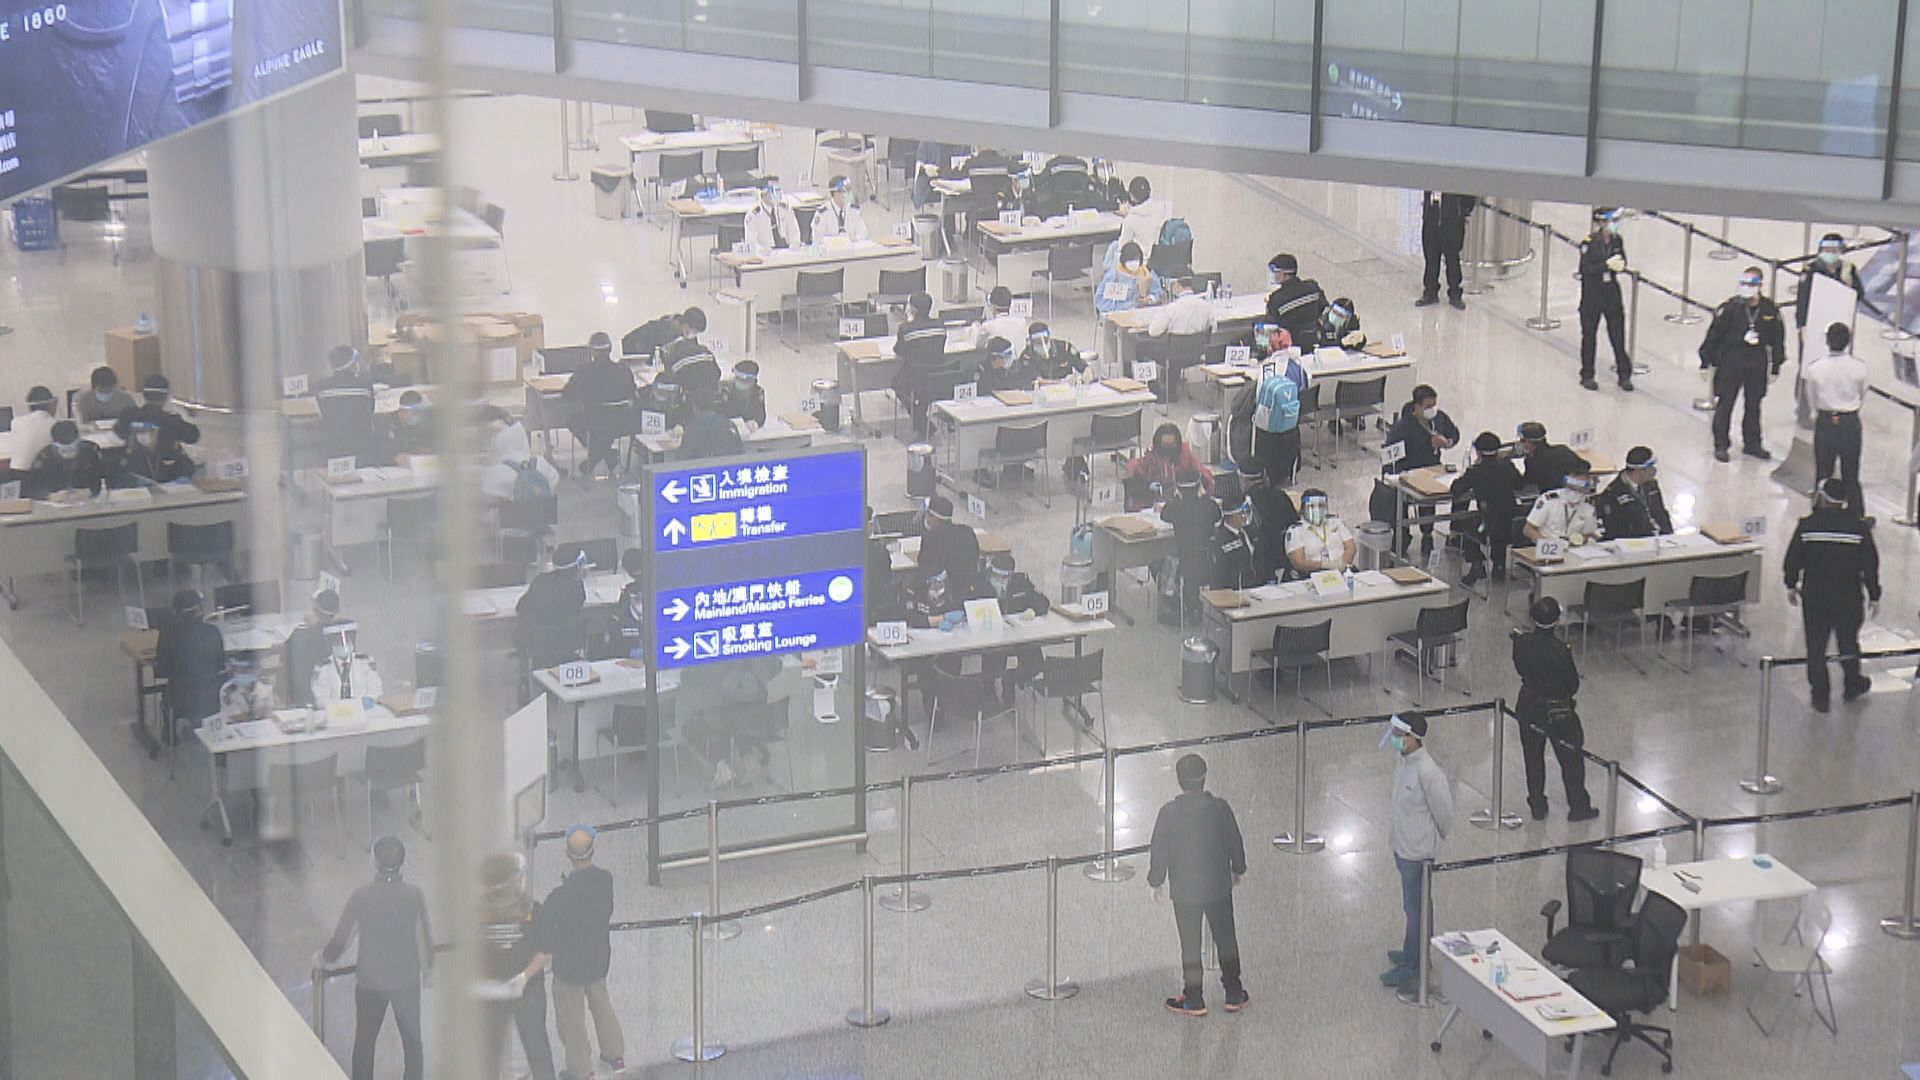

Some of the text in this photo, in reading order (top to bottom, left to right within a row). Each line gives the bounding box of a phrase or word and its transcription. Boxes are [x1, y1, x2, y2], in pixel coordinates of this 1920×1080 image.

[23, 3, 66, 32] 1860
[292, 39, 325, 64] EAGLE
[719, 482, 788, 500] Immigration
[740, 521, 787, 537] Transfer
[694, 594, 826, 621] Mainland/Macao Ferries
[722, 632, 817, 656] Smoking Lounge
